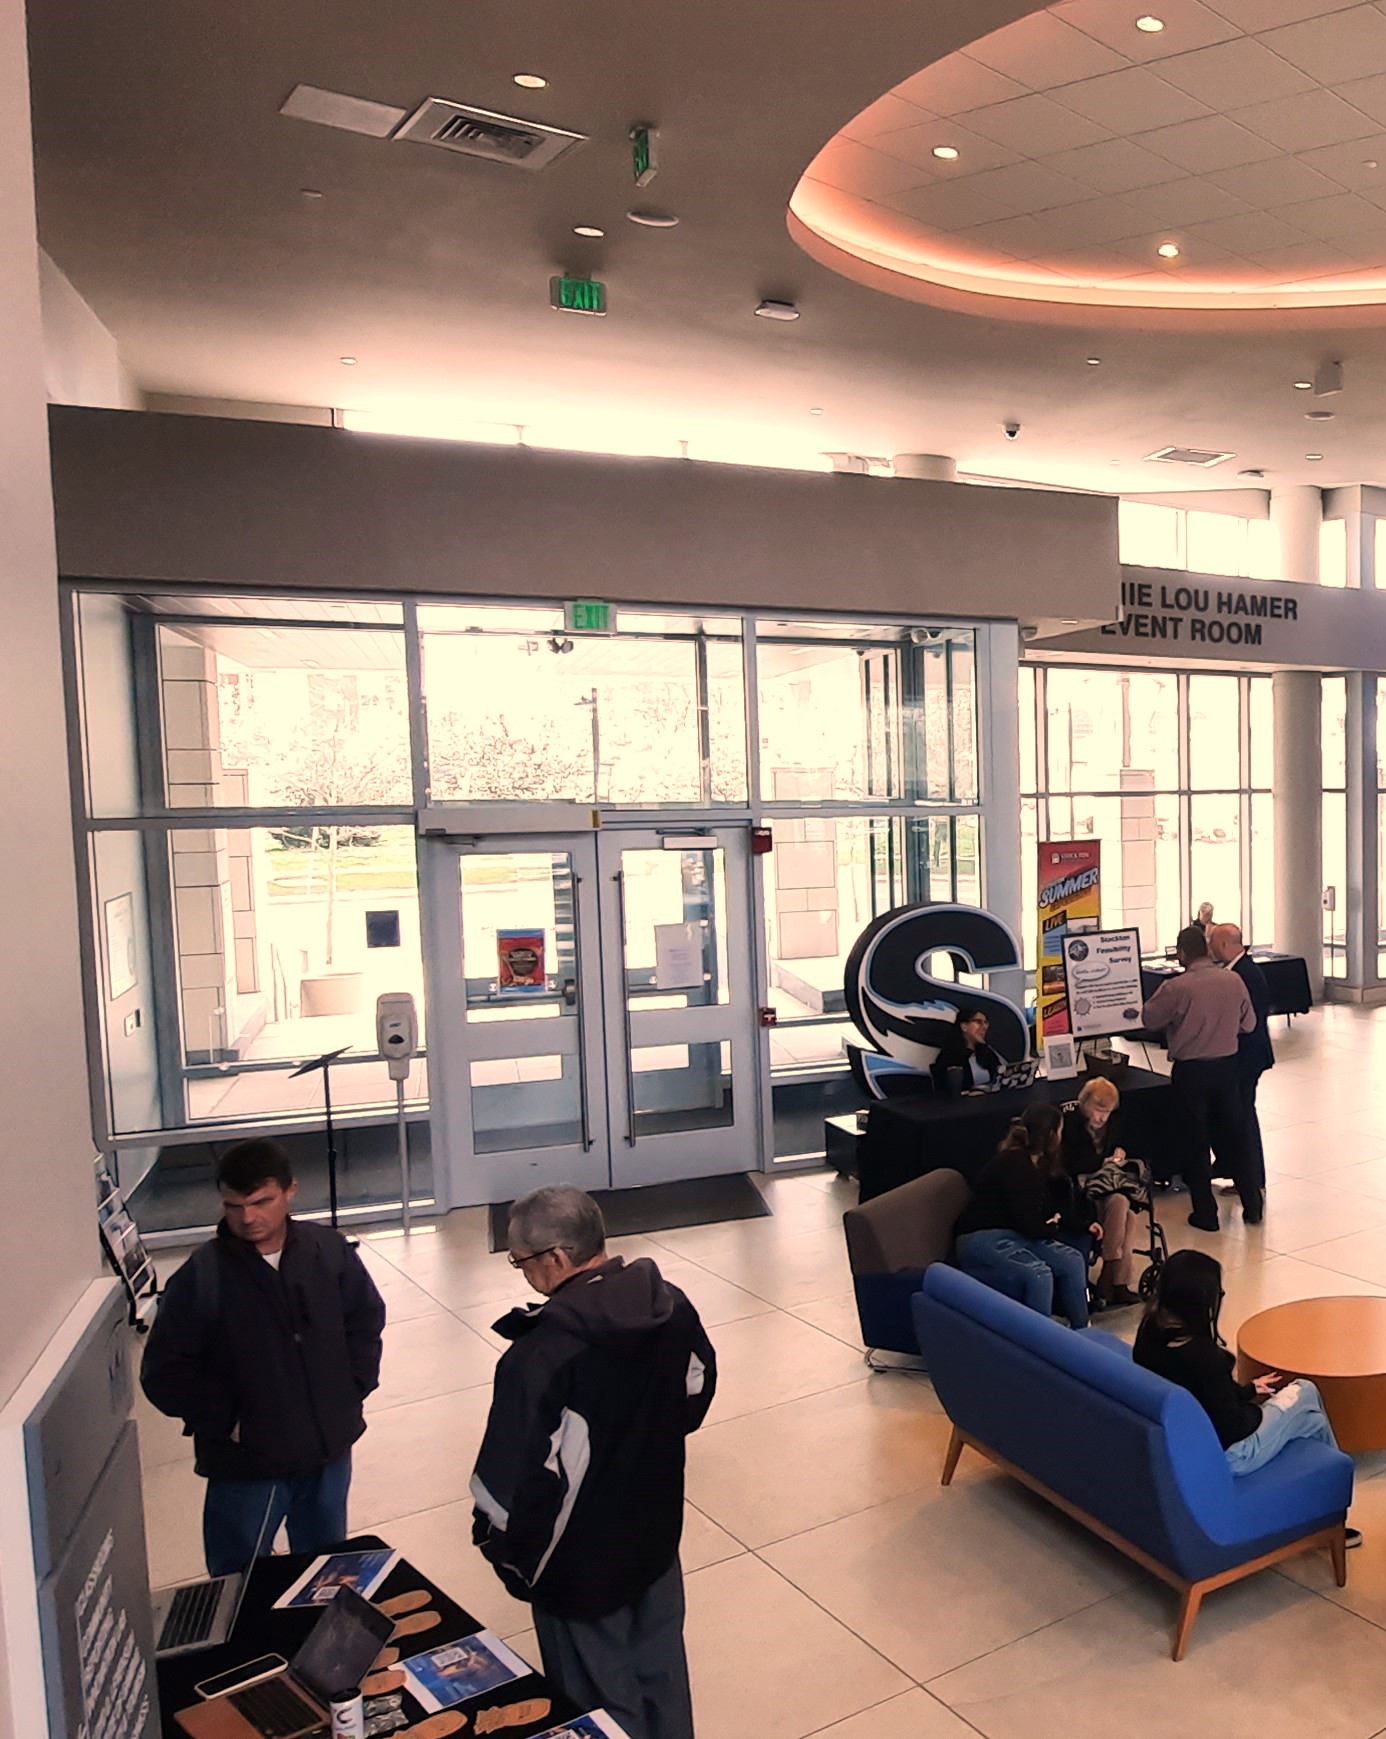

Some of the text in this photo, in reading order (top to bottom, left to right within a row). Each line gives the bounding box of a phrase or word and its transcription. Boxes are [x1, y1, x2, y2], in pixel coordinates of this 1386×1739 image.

[572, 602, 608, 629] EXIT
[1160, 585, 1209, 612] LOU
[1217, 591, 1298, 620] HAMER
[1190, 618, 1263, 645] ROOM
[1038, 866, 1099, 908] SUMMER
